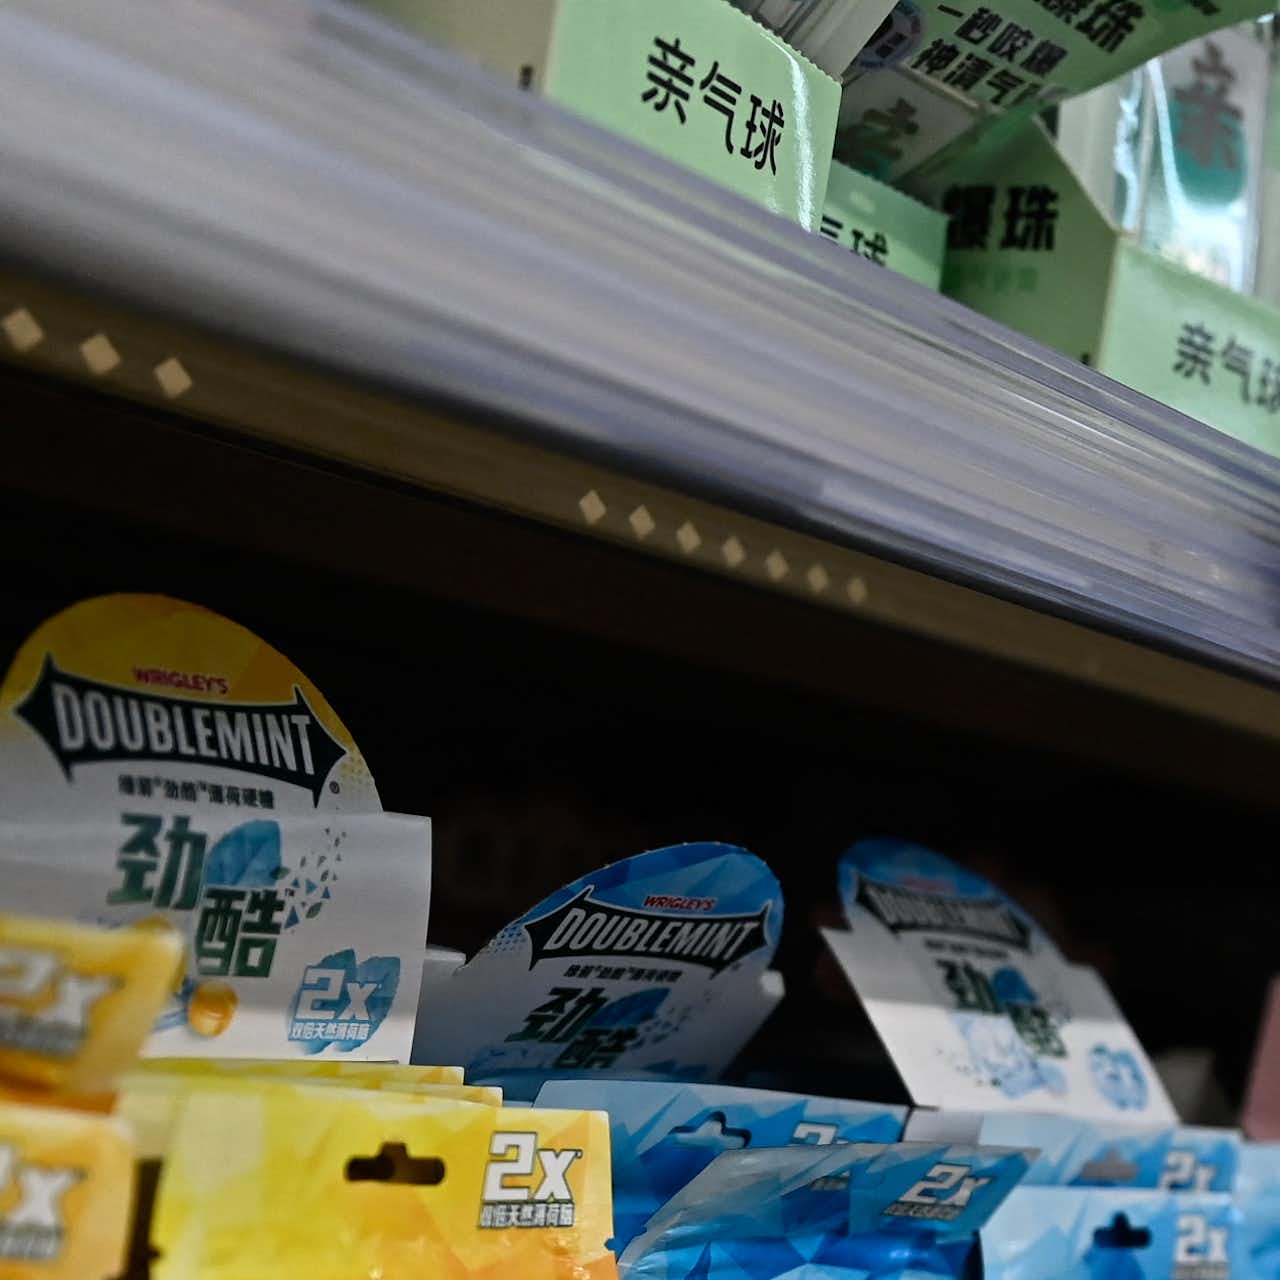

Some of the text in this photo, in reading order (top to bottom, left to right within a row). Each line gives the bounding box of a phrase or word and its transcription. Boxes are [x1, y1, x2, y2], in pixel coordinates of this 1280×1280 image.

[640, 36, 786, 177] 亲气球
[132, 666, 229, 696] WRIGLEY'S
[50, 682, 317, 776] DOUBLEMINT
[106, 812, 286, 979] 劲酷
[543, 907, 761, 961] DOUBLEMINT
